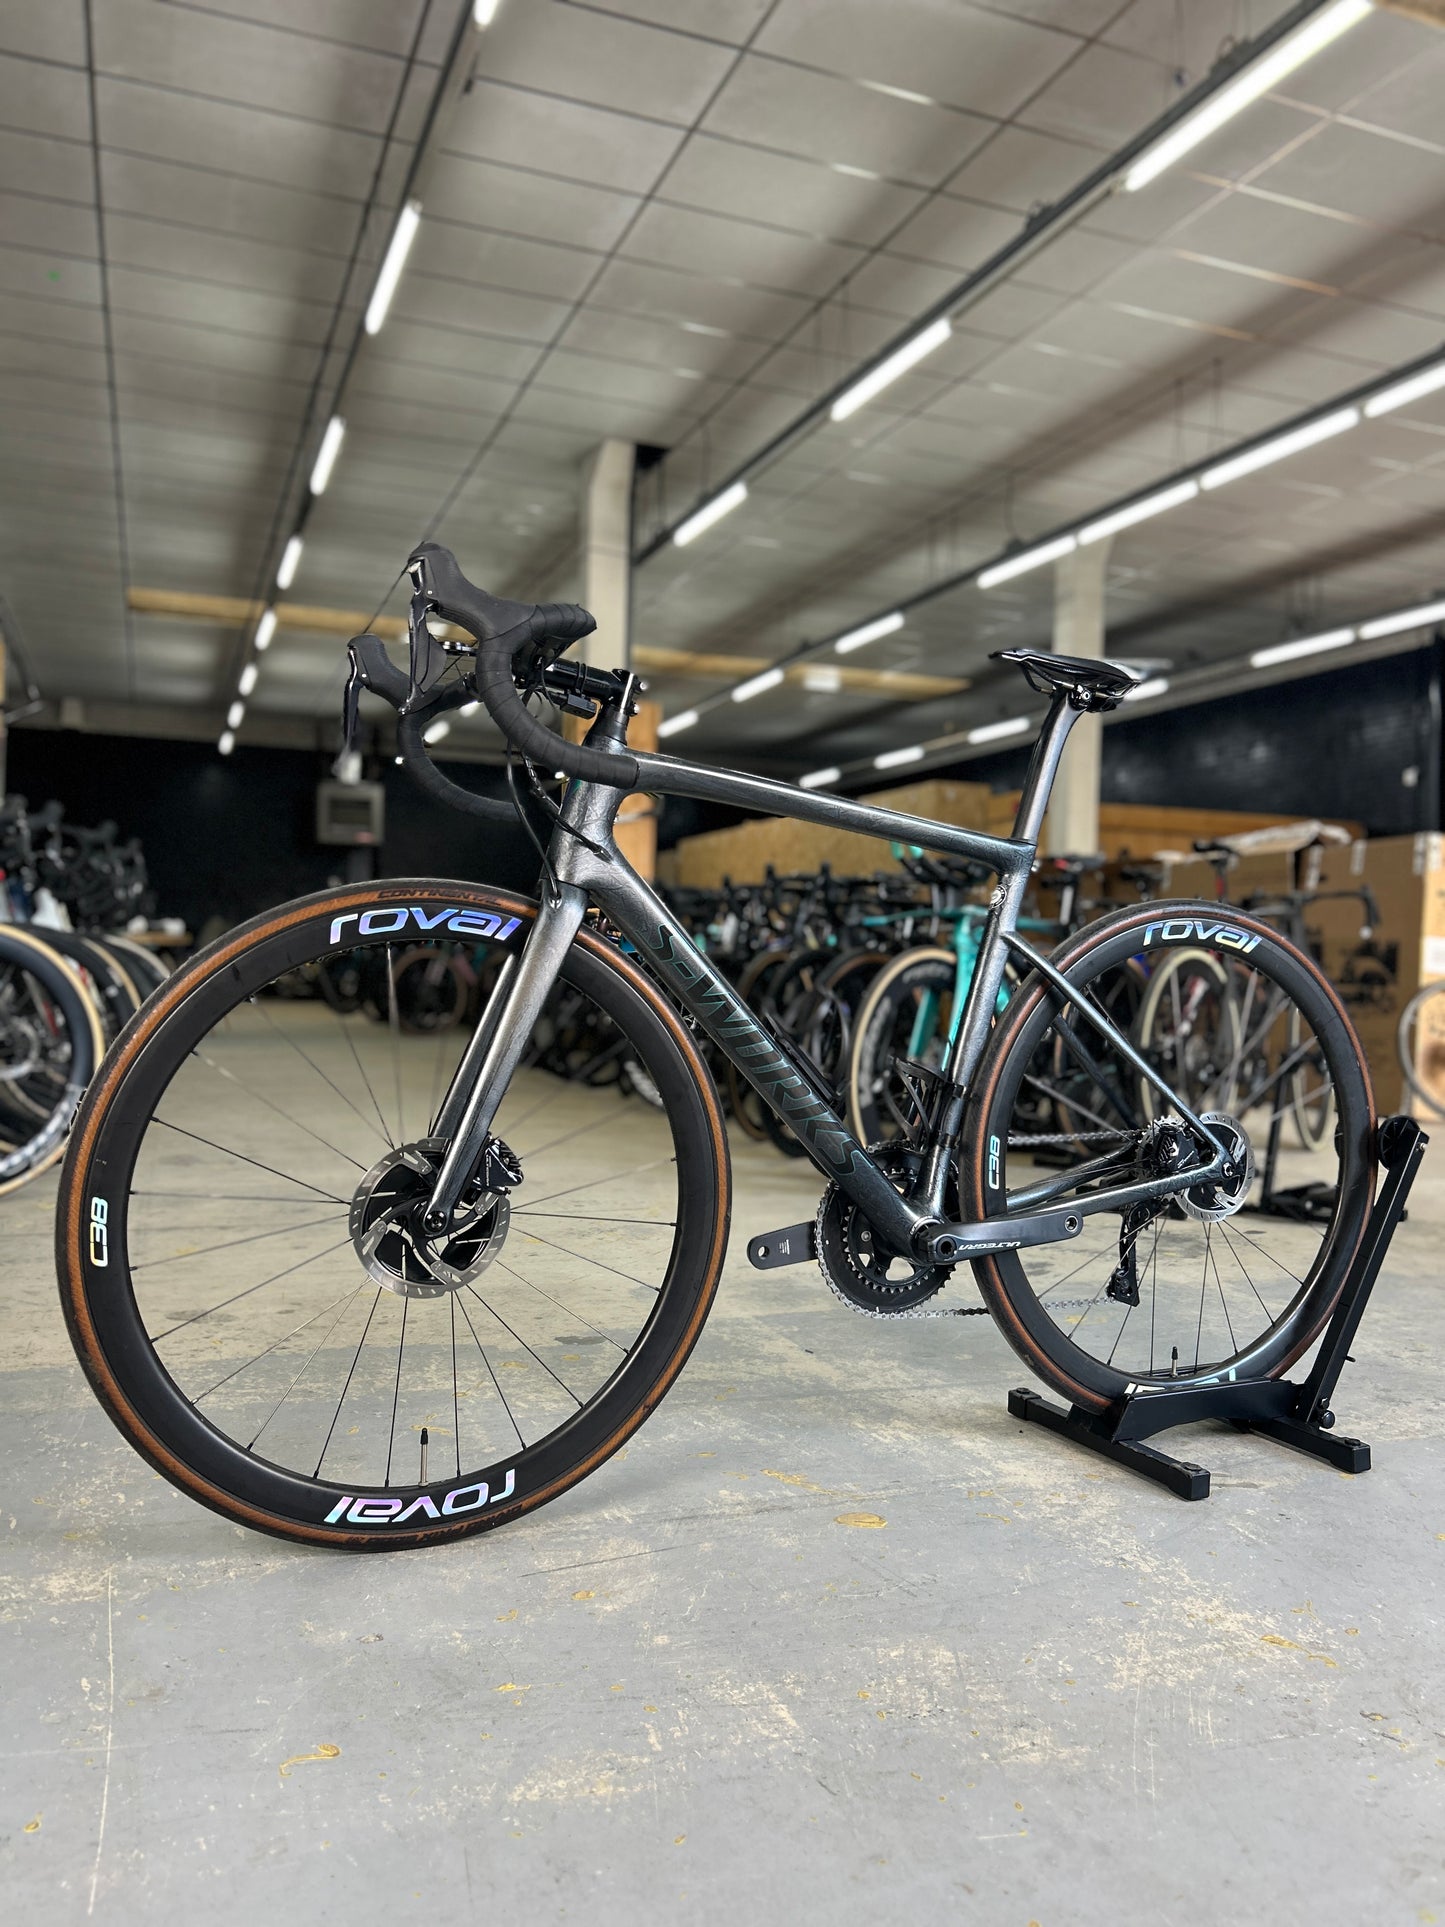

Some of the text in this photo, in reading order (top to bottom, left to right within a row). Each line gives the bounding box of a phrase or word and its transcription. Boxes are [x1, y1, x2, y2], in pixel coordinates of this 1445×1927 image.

[329, 907, 523, 945] roval
[1143, 920, 1263, 954] roval
[634, 923, 875, 1175] S-WORKS
[989, 1135, 1001, 1190] C38
[90, 1197, 109, 1267] C38
[958, 1241, 1021, 1251] ULTEGRA
[324, 1468, 516, 1523] roval
